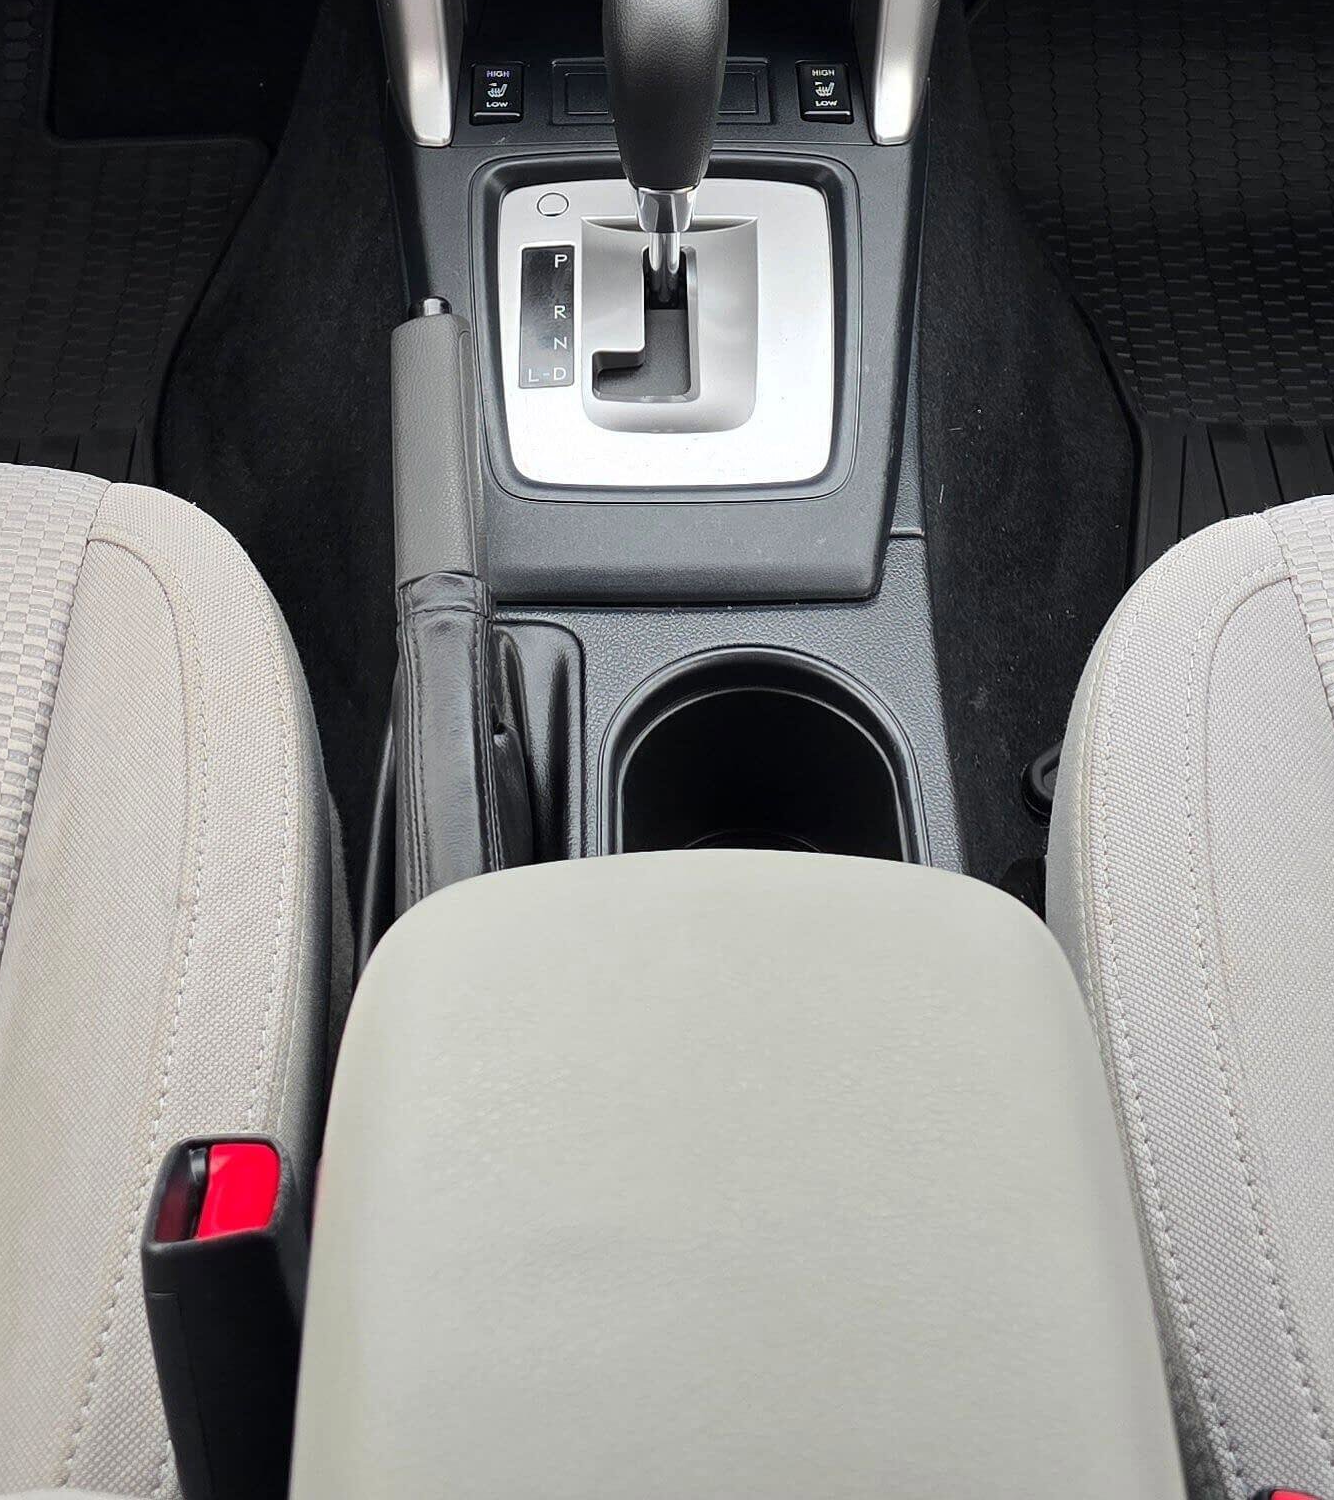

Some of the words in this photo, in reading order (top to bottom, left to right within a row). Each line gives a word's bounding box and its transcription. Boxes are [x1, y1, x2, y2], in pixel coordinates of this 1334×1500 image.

[486, 70, 510, 78] HIGH
[554, 255, 567, 268] P
[554, 305, 567, 318] R
[553, 337, 567, 350] N
